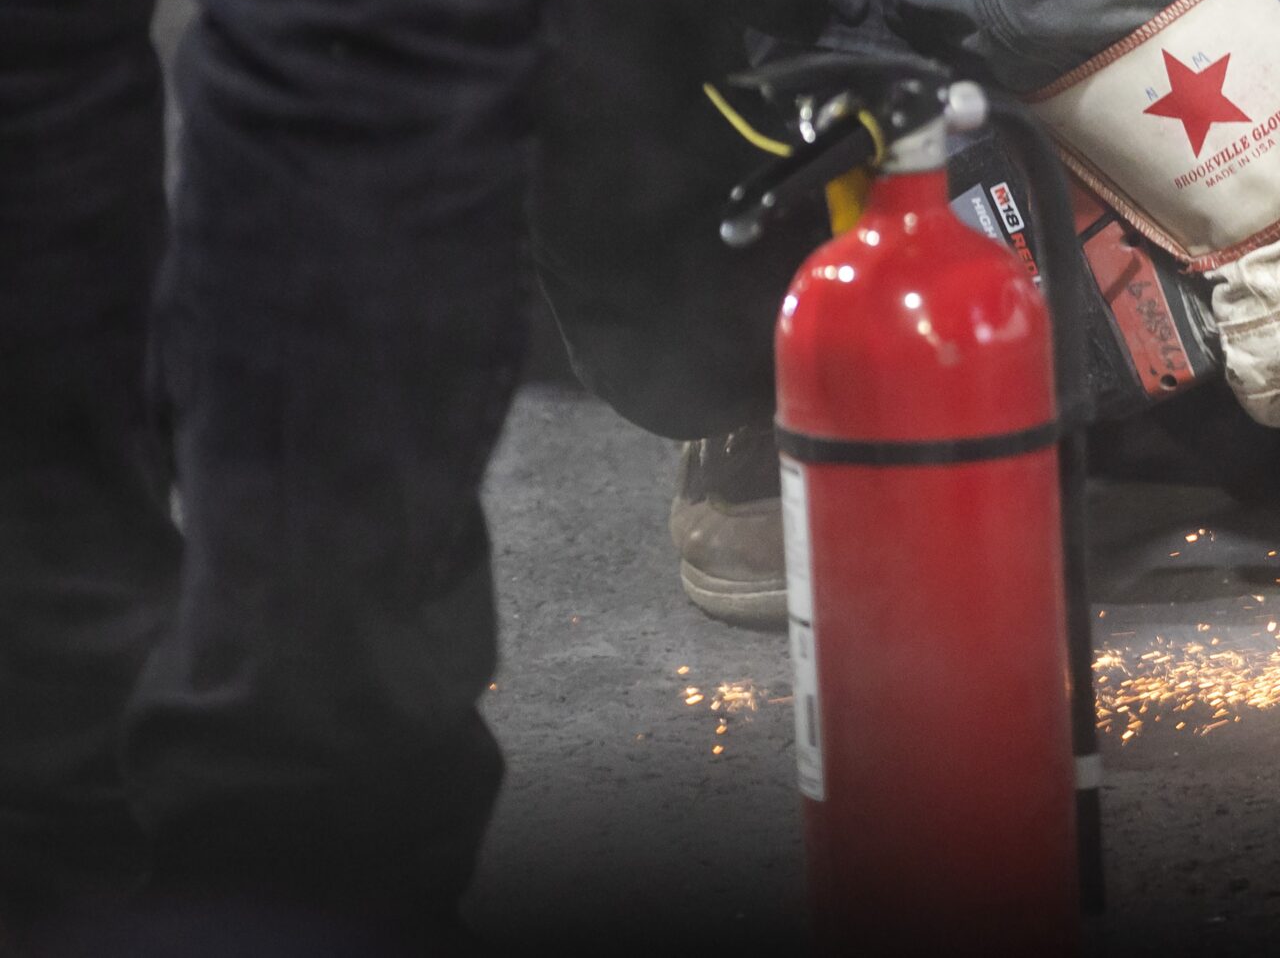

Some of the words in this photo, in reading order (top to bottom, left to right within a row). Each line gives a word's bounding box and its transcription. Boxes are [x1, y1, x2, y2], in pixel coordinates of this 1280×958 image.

[1174, 135, 1250, 190] BROOKVILLE
[1205, 166, 1237, 188] MADE
[1238, 156, 1250, 168] IN
[1252, 138, 1275, 158] USA
[971, 197, 999, 239] HIGH
[994, 187, 1020, 227] M18
